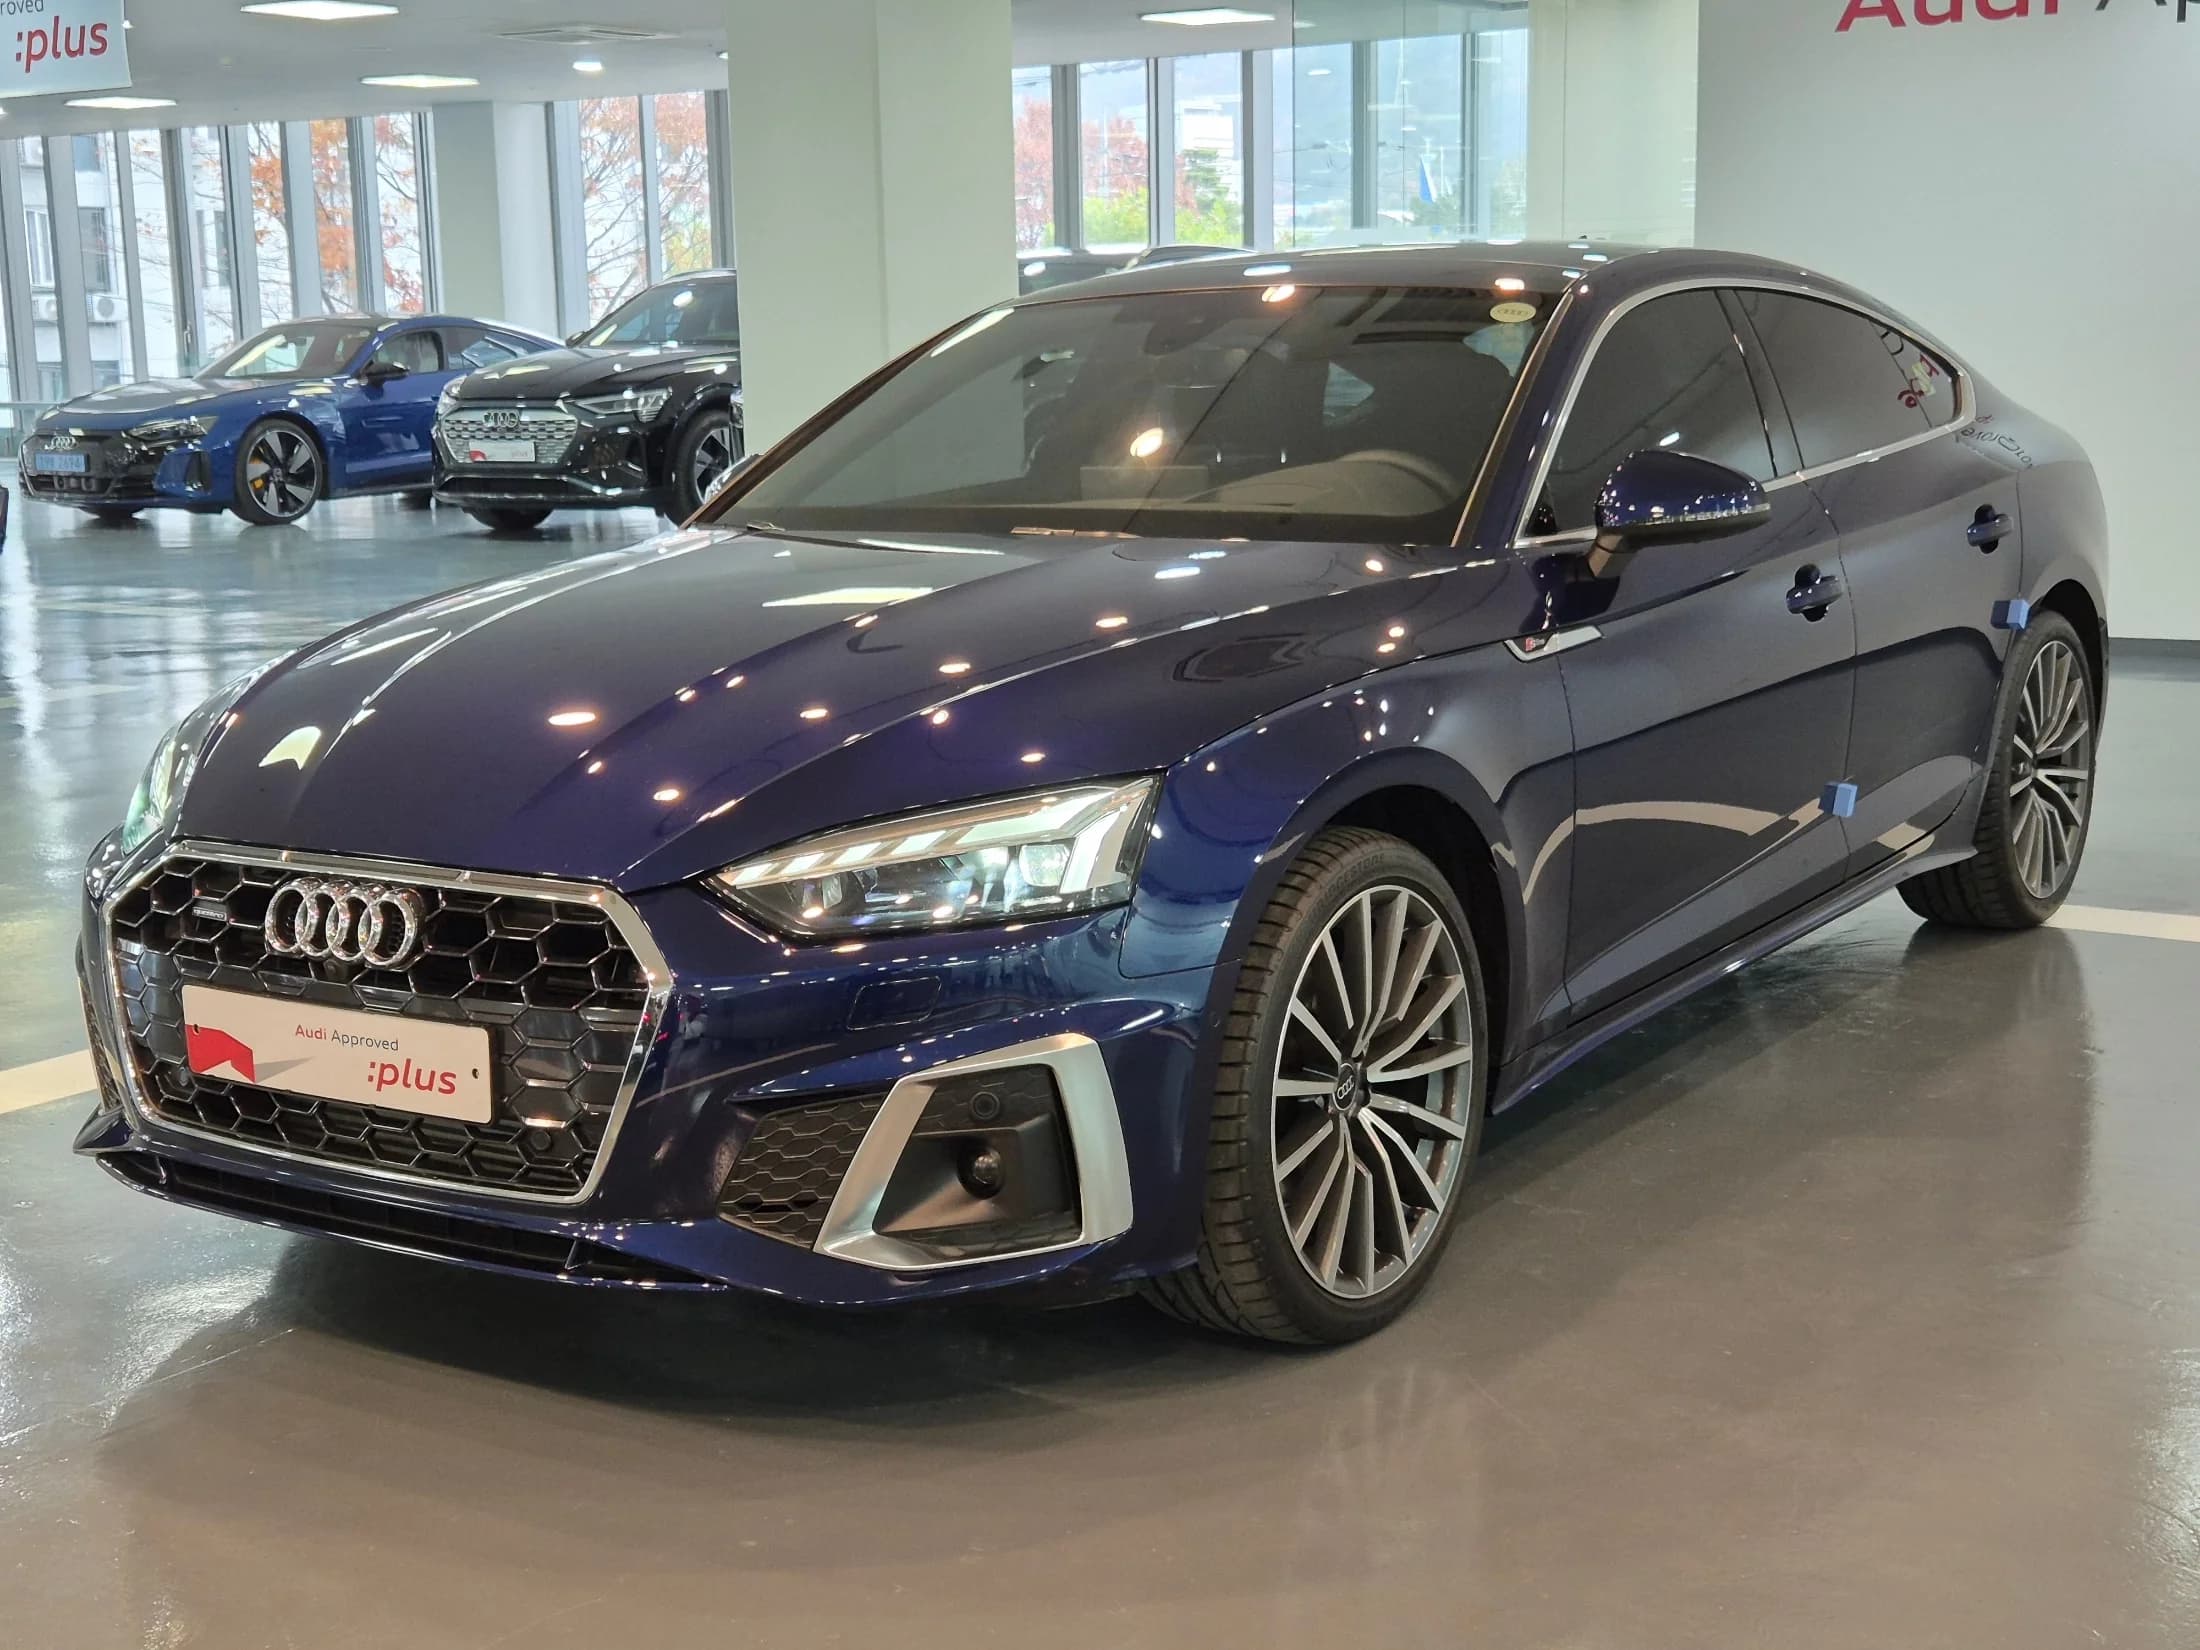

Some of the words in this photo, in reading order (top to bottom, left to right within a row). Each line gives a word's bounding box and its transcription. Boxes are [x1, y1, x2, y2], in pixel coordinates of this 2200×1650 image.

[16, 15, 108, 73] :plus
[295, 1024, 327, 1040] Audi
[331, 1030, 399, 1051] Approved
[368, 1058, 457, 1095] :plus
